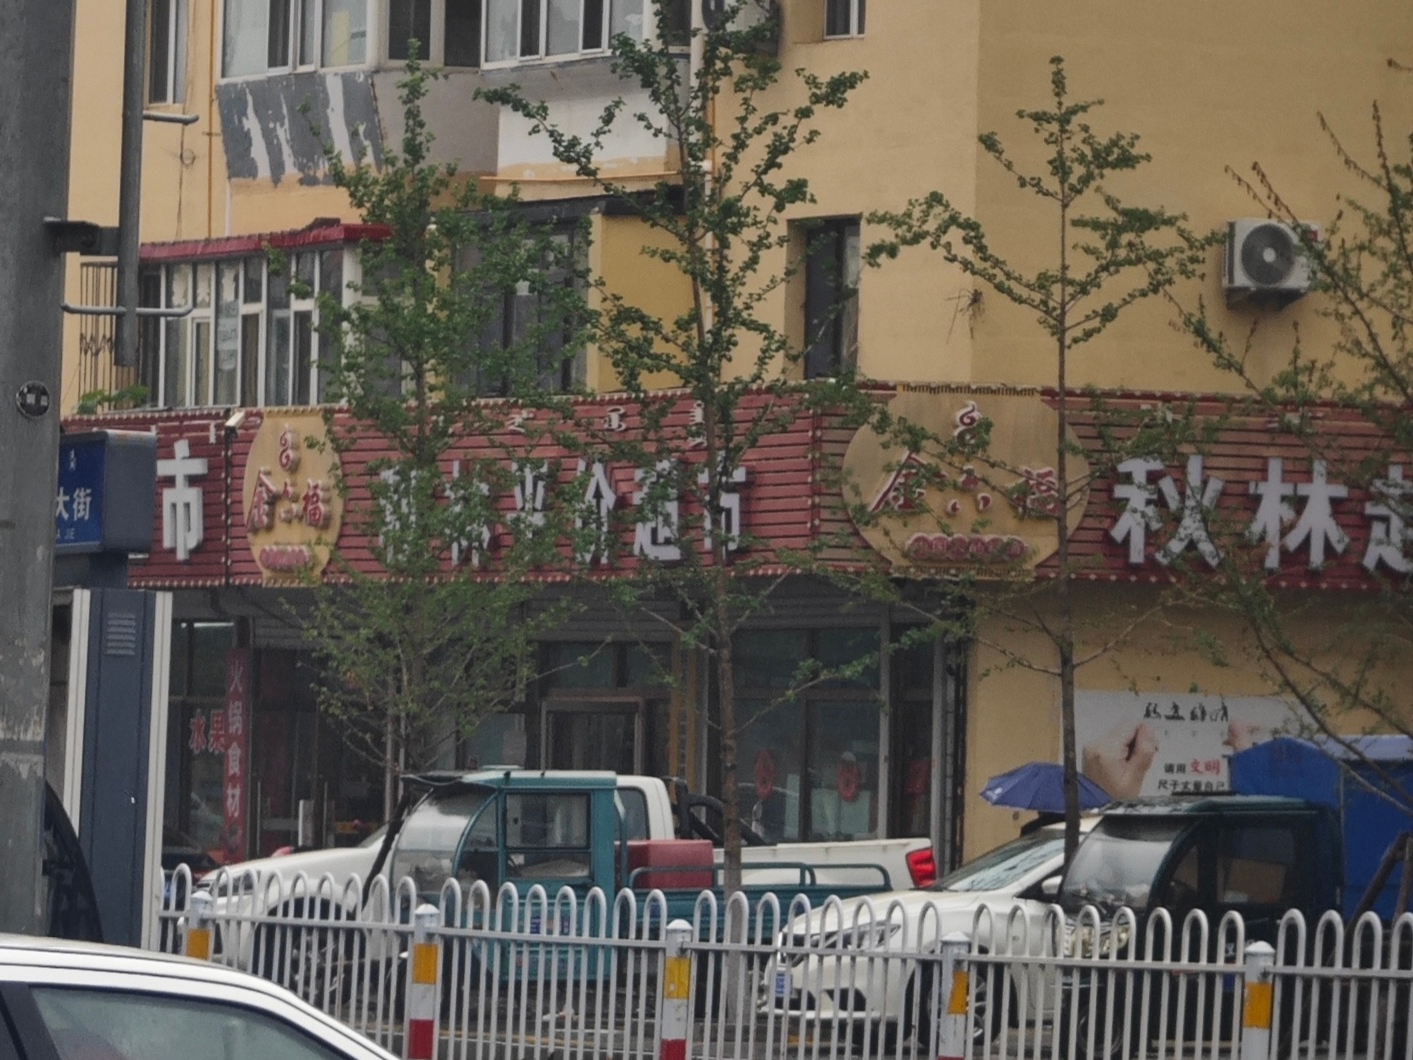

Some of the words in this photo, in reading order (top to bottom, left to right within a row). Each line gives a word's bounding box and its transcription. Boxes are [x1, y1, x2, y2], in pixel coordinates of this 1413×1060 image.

[157, 439, 209, 561] 市
[189, 709, 225, 754] 水果
[227, 664, 244, 818] 火锅食材
